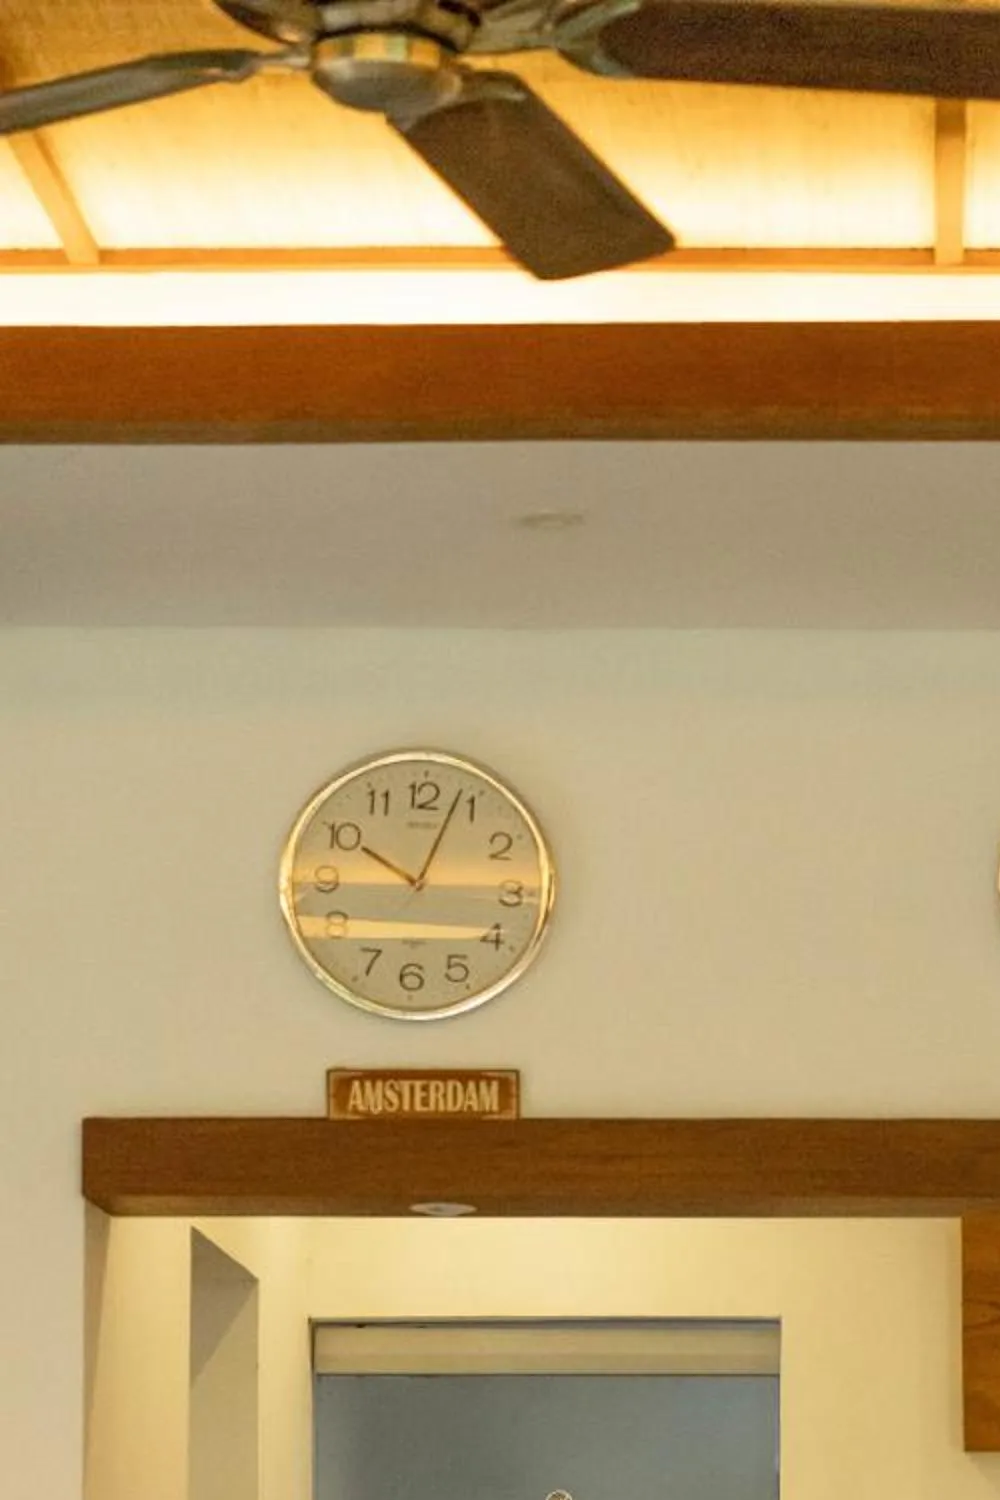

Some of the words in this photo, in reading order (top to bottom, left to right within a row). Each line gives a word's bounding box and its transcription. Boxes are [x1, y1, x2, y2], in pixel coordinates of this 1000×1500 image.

[367, 790, 390, 816] 11
[409, 781, 440, 810] 12
[466, 795, 475, 823] 1
[328, 823, 361, 851] 10
[489, 831, 513, 861] 2
[314, 865, 339, 893] 9
[498, 880, 524, 907] 3
[325, 910, 349, 939] 8
[479, 923, 504, 950] 4
[361, 948, 383, 976] 7
[445, 954, 469, 983] 5
[400, 963, 425, 991] 6
[349, 1079, 499, 1114] AMSTERDAM
